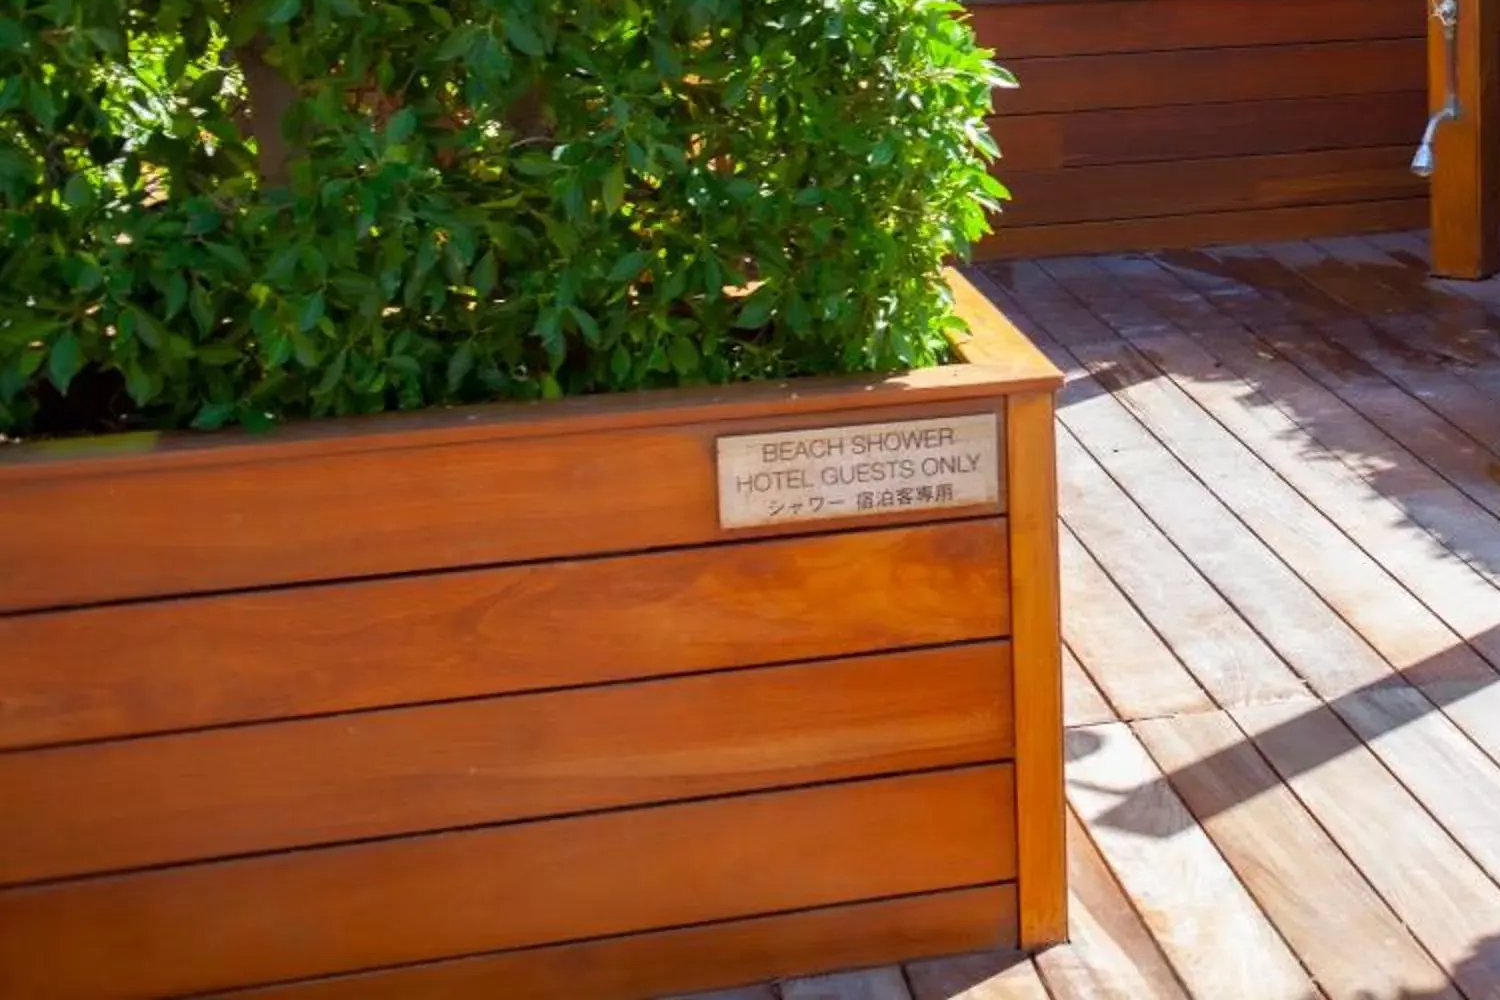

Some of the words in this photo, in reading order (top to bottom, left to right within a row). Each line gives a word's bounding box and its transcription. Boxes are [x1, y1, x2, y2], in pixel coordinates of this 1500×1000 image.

[762, 437, 844, 463] BEACH
[851, 427, 954, 455] SHOWER
[736, 469, 814, 494] HOTEL
[820, 460, 914, 486] GUESTS
[921, 453, 982, 476] ONLY
[767, 496, 845, 517] シャワー
